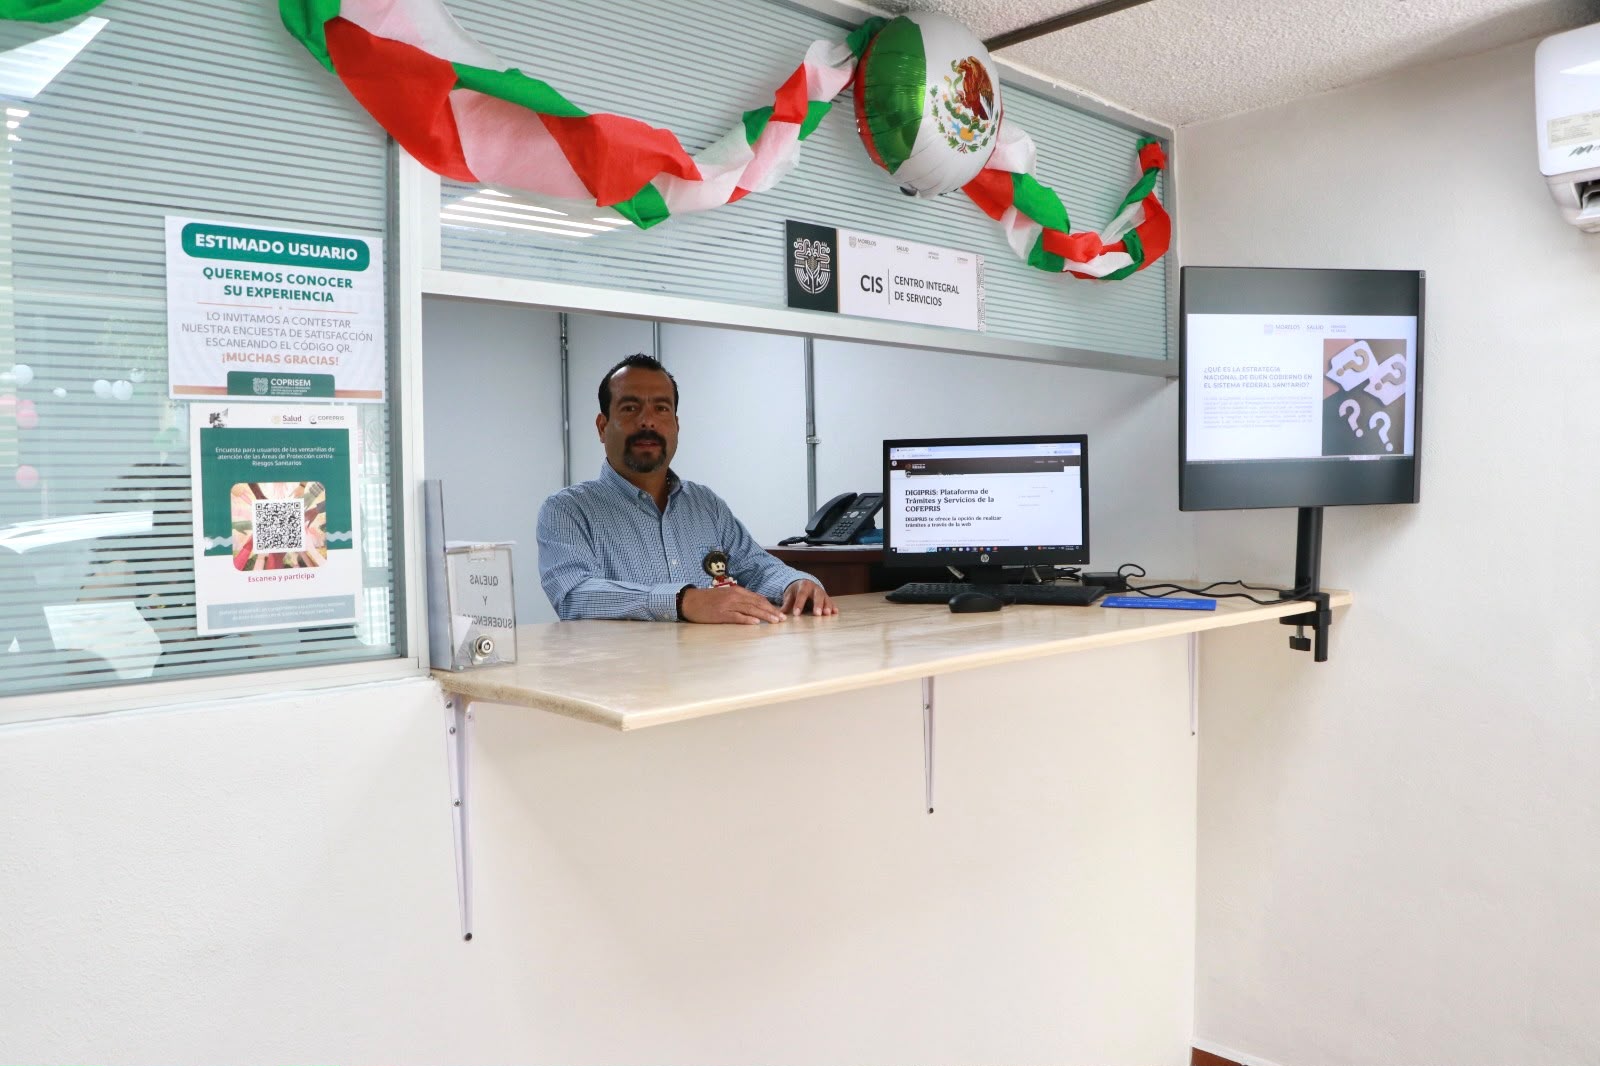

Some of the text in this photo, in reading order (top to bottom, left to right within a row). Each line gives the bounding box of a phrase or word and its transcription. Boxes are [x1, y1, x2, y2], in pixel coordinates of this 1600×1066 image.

[196, 234, 358, 261] ESTIMADO USUARIO
[202, 267, 352, 288] QUEREMOS CONOCER
[860, 274, 883, 293] CIS
[894, 276, 959, 294] CENTRO INTEGRAL
[224, 285, 334, 302] SU EXPERIENCIA
[894, 291, 942, 306] DE SERVICIOS
[206, 312, 351, 328] LO INVITAMOS A CONTESTAR
[182, 323, 373, 342] NUESTRA ENCUESTA DE SATISFACCIÓN
[206, 338, 352, 353] ESCANEANDO EL CÓDIGO QR.
[222, 353, 339, 365] ¡MUCHAS GRACIAS!
[284, 573, 315, 581] participa
